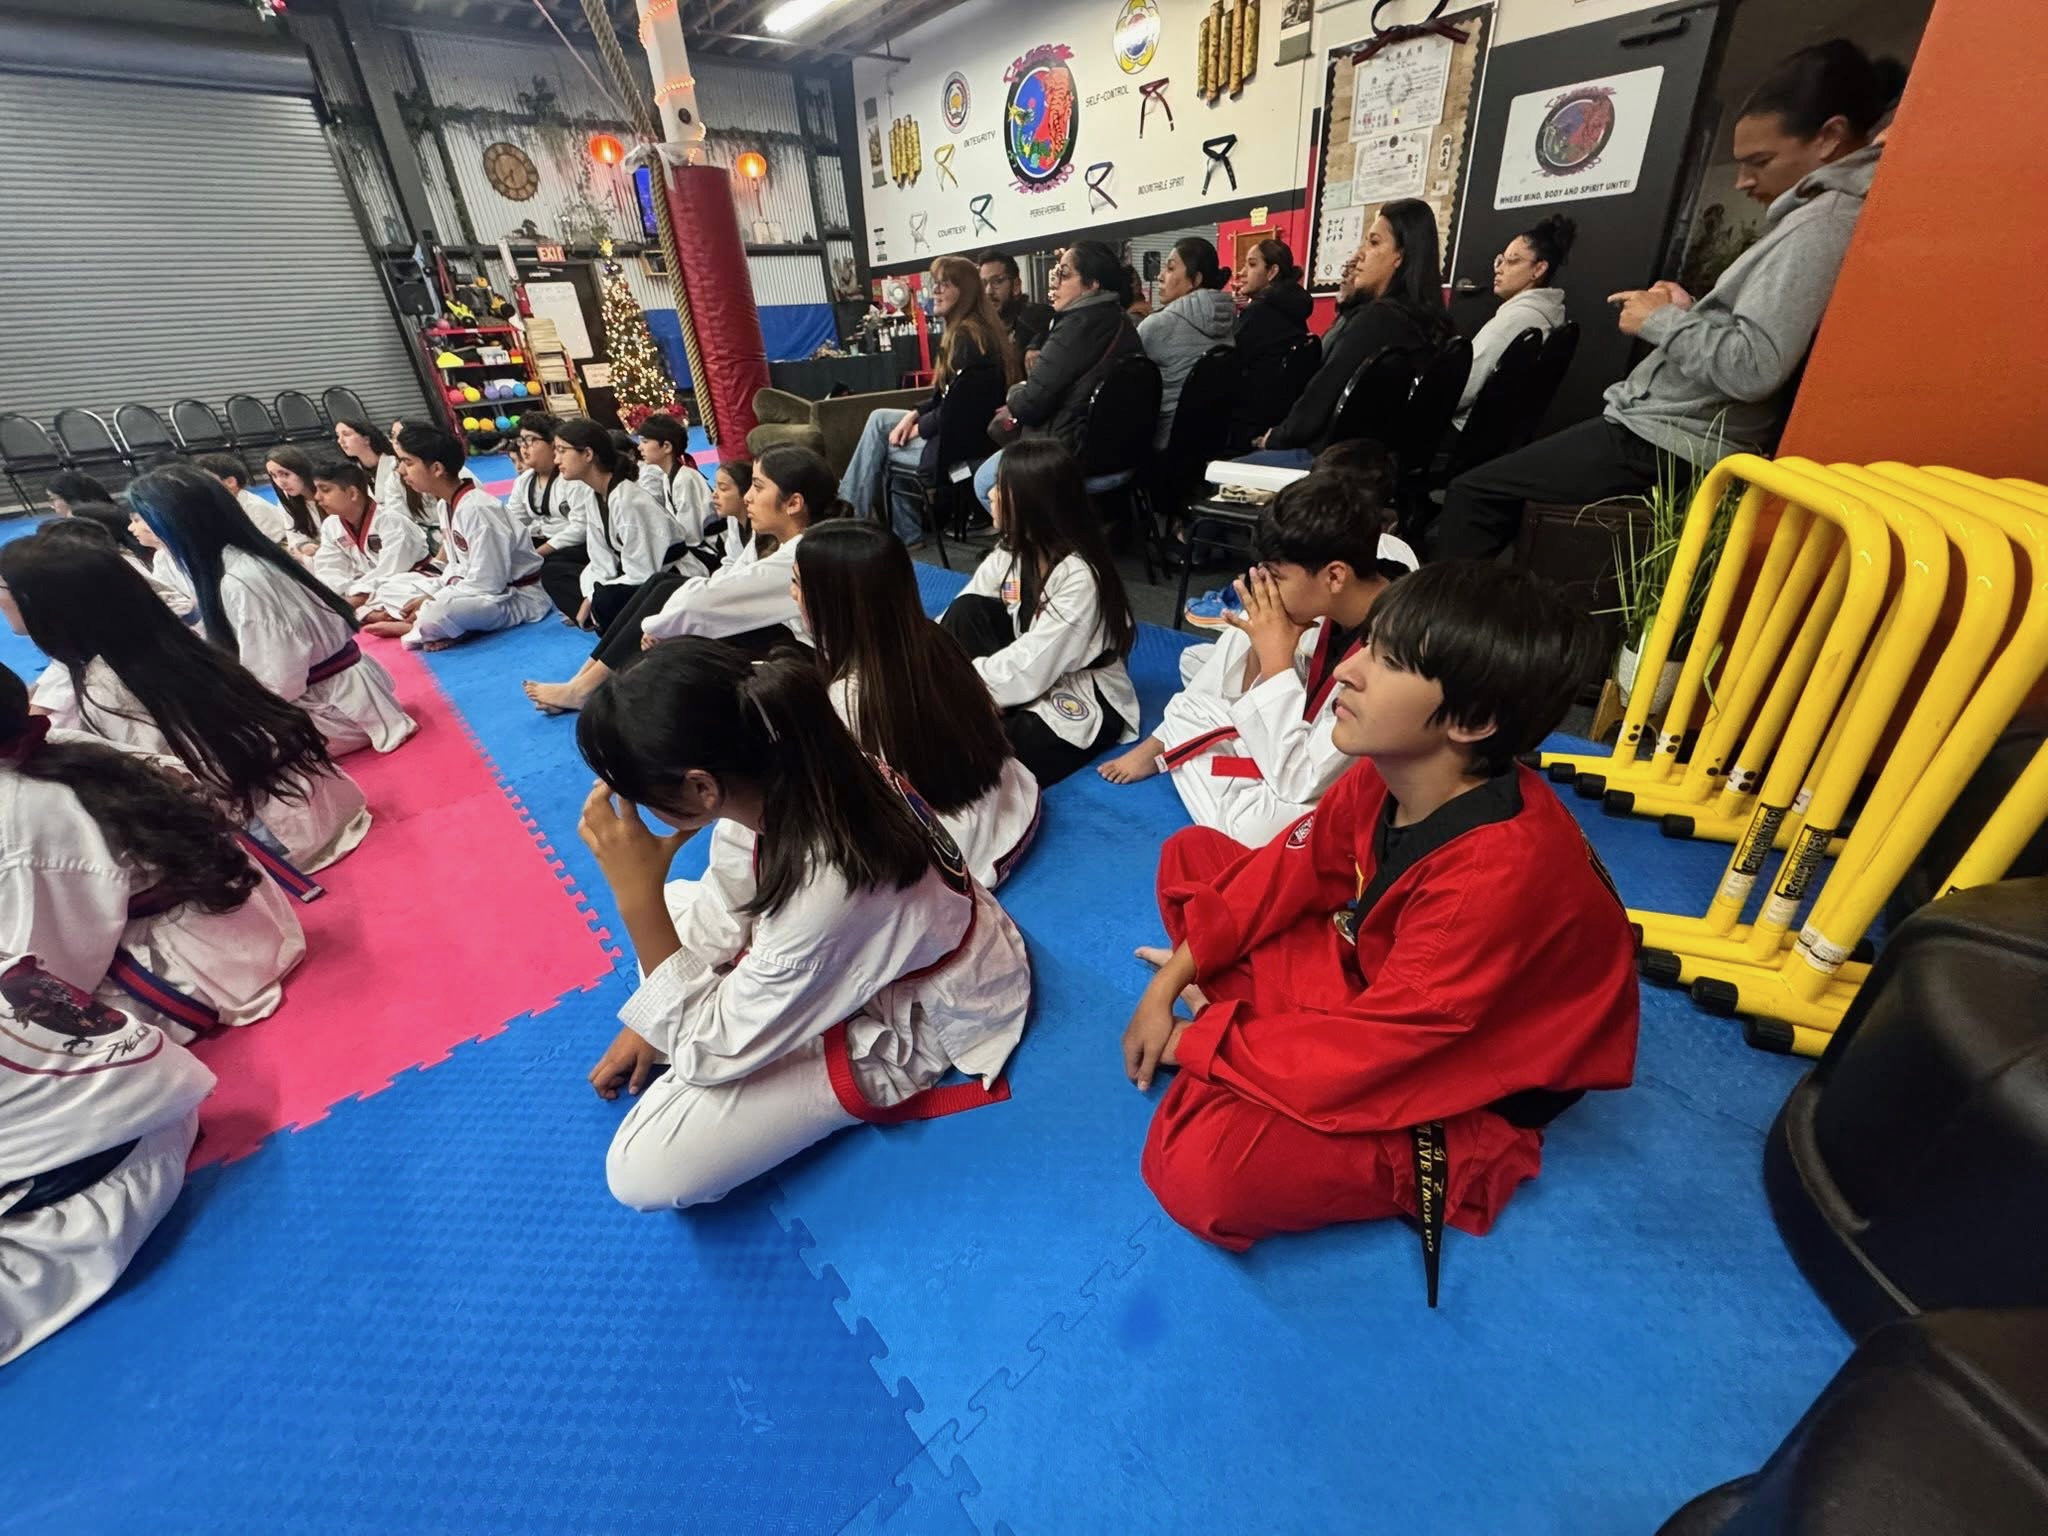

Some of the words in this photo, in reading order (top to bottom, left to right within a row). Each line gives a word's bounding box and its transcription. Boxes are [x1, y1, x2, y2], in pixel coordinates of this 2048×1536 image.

[1085, 84, 1129, 107] SELF-CONTROL
[963, 130, 996, 148] INTEGRITY
[1500, 194, 1522, 204] WHERE
[1523, 192, 1542, 201] MIND,
[1544, 190, 1563, 199] BODY
[1564, 186, 1578, 196] AND
[1580, 183, 1604, 194] SPIRIT
[1606, 180, 1631, 190] UNITE!
[937, 225, 967, 238] COURTESY
[541, 248, 562, 262] EXIT
